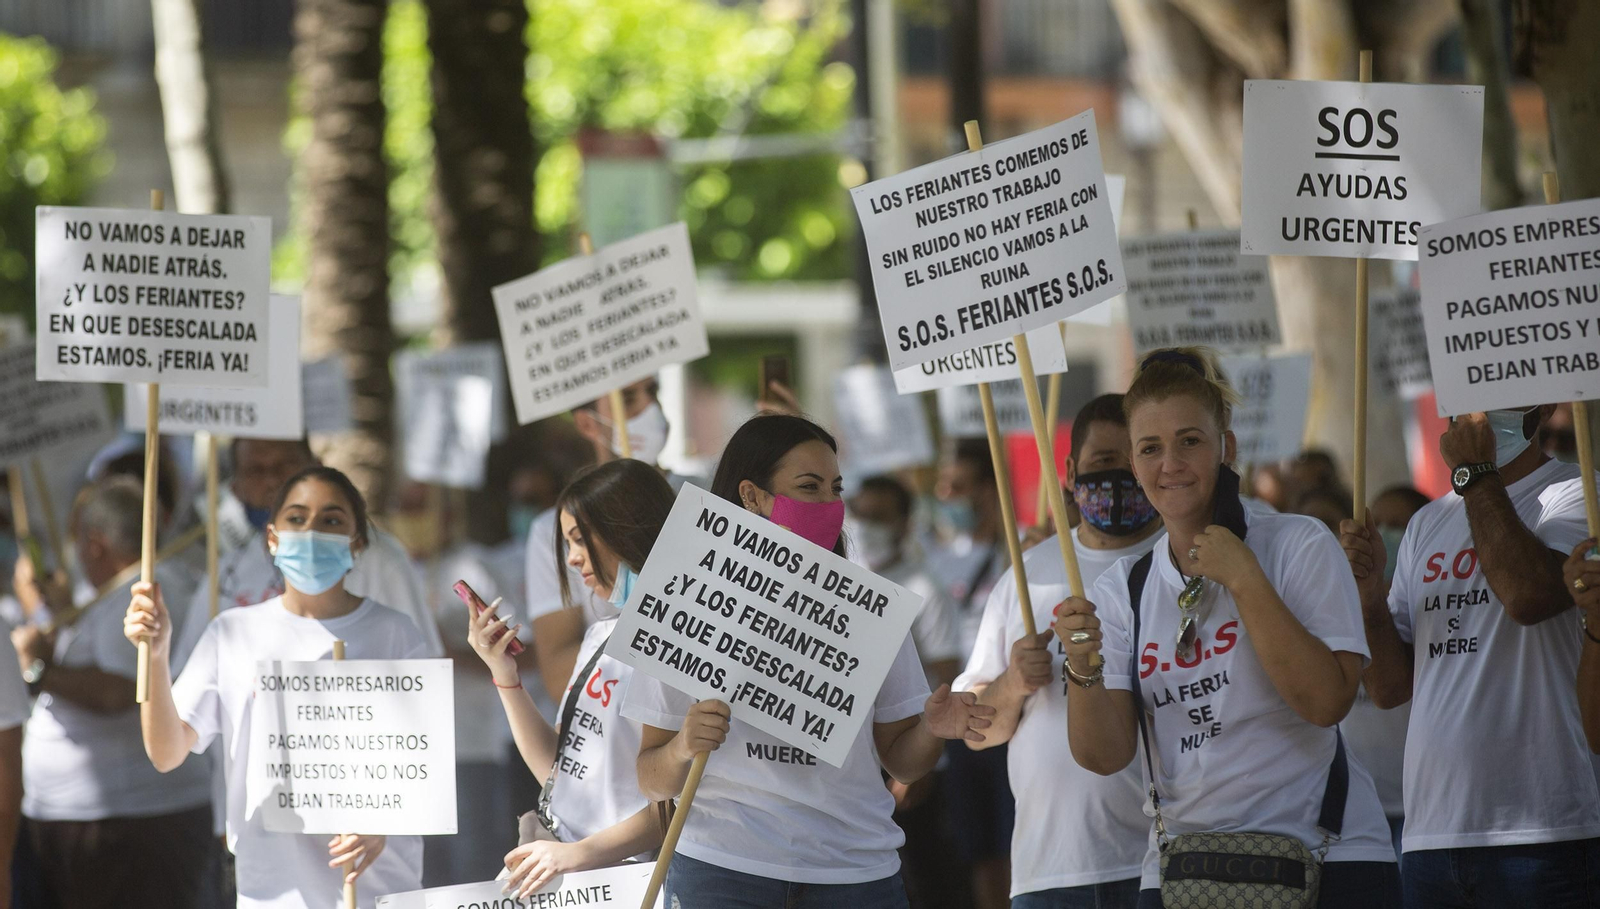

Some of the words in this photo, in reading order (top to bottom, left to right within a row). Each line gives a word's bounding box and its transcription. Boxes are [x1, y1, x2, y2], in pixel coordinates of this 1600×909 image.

[1317, 107, 1399, 149] SOS
[870, 191, 902, 214] LOS
[905, 164, 991, 204] FERIANTES
[995, 138, 1068, 176] COMEMOS
[1071, 129, 1088, 150] DE
[915, 192, 989, 228] NUESTRO
[992, 168, 1061, 204] TRABAJO
[1296, 173, 1407, 201] AYUDAS
[65, 222, 92, 241] NO
[99, 223, 164, 244] VAMOS
[170, 226, 181, 245] A
[188, 227, 245, 249] DEJAR
[882, 248, 909, 269] SIN
[912, 232, 960, 260] RUIDO
[964, 224, 987, 243] NO
[991, 212, 1021, 236] HAY
[1026, 197, 1068, 225] FERIA
[1071, 183, 1098, 208] CON
[1282, 217, 1421, 246] URGENTES
[904, 270, 924, 288] EL
[927, 246, 999, 280] SILENCIO
[1002, 227, 1055, 257] VAMOS
[1060, 223, 1069, 239] A
[1071, 214, 1089, 234] LA
[1427, 227, 1507, 257] SOMOS
[82, 253, 95, 271] A
[102, 254, 159, 274] NADIE
[165, 254, 227, 279] ATRÁS.
[980, 262, 1030, 289] RUINA
[1489, 250, 1600, 280] FERIANTES
[63, 283, 86, 307] ¿Y
[93, 284, 129, 304] LOS
[136, 286, 245, 310] FERIANTES?
[898, 314, 955, 352] S.O.S.
[957, 278, 1063, 334] FERIANTES
[1067, 259, 1113, 298] S.O.S.
[1446, 289, 1559, 320] PAGAMOS
[50, 314, 74, 333] EN
[82, 315, 121, 334] QUE
[128, 317, 257, 342] DESESCALADA
[1445, 321, 1571, 354] IMPUESTOS
[1576, 319, 1589, 337] Y
[57, 345, 152, 367] ESTAMOS.
[158, 349, 215, 373] ¡FERIA
[221, 353, 248, 372] YA!
[1467, 358, 1536, 384] DEJAN
[159, 398, 258, 426] RGENTES
[696, 508, 729, 537] NO
[733, 524, 803, 574] VAMOS
[802, 562, 820, 584] A
[822, 570, 889, 617] DEJAR
[698, 549, 716, 572] A
[718, 557, 784, 603] NADIE
[782, 590, 850, 639] ATRÁS.
[664, 573, 697, 596] ¿Y
[695, 583, 737, 618] LOS
[738, 605, 859, 677] FERIANTES?
[637, 593, 670, 623] EN
[671, 611, 716, 646] QUE
[715, 632, 855, 716] DESESCALADA
[1140, 620, 1239, 679] S.O.S
[261, 674, 310, 692] SOMOS
[314, 675, 423, 692] EMPRESARIOS
[630, 628, 727, 693] ESTAMOS.
[729, 681, 796, 726] ¡FERIA
[801, 710, 835, 743] YA!
[1153, 687, 1177, 709] LA
[1178, 670, 1230, 702] FERIA
[298, 705, 373, 721] FERIANTES
[1188, 704, 1215, 725] SE
[269, 734, 340, 750] PAGAMOS
[345, 734, 428, 750] NUESTROS
[565, 731, 586, 752] SE
[746, 742, 817, 766] MUERE
[267, 763, 346, 780] IMPUESTOS
[350, 764, 359, 779] Y
[365, 764, 387, 780] NO
[394, 764, 428, 780] NOS
[277, 791, 322, 809] DEJAN
[327, 793, 402, 809] TRABAJAR
[1181, 857, 1280, 879] GUCCI
[530, 885, 612, 909] FERIANTE
